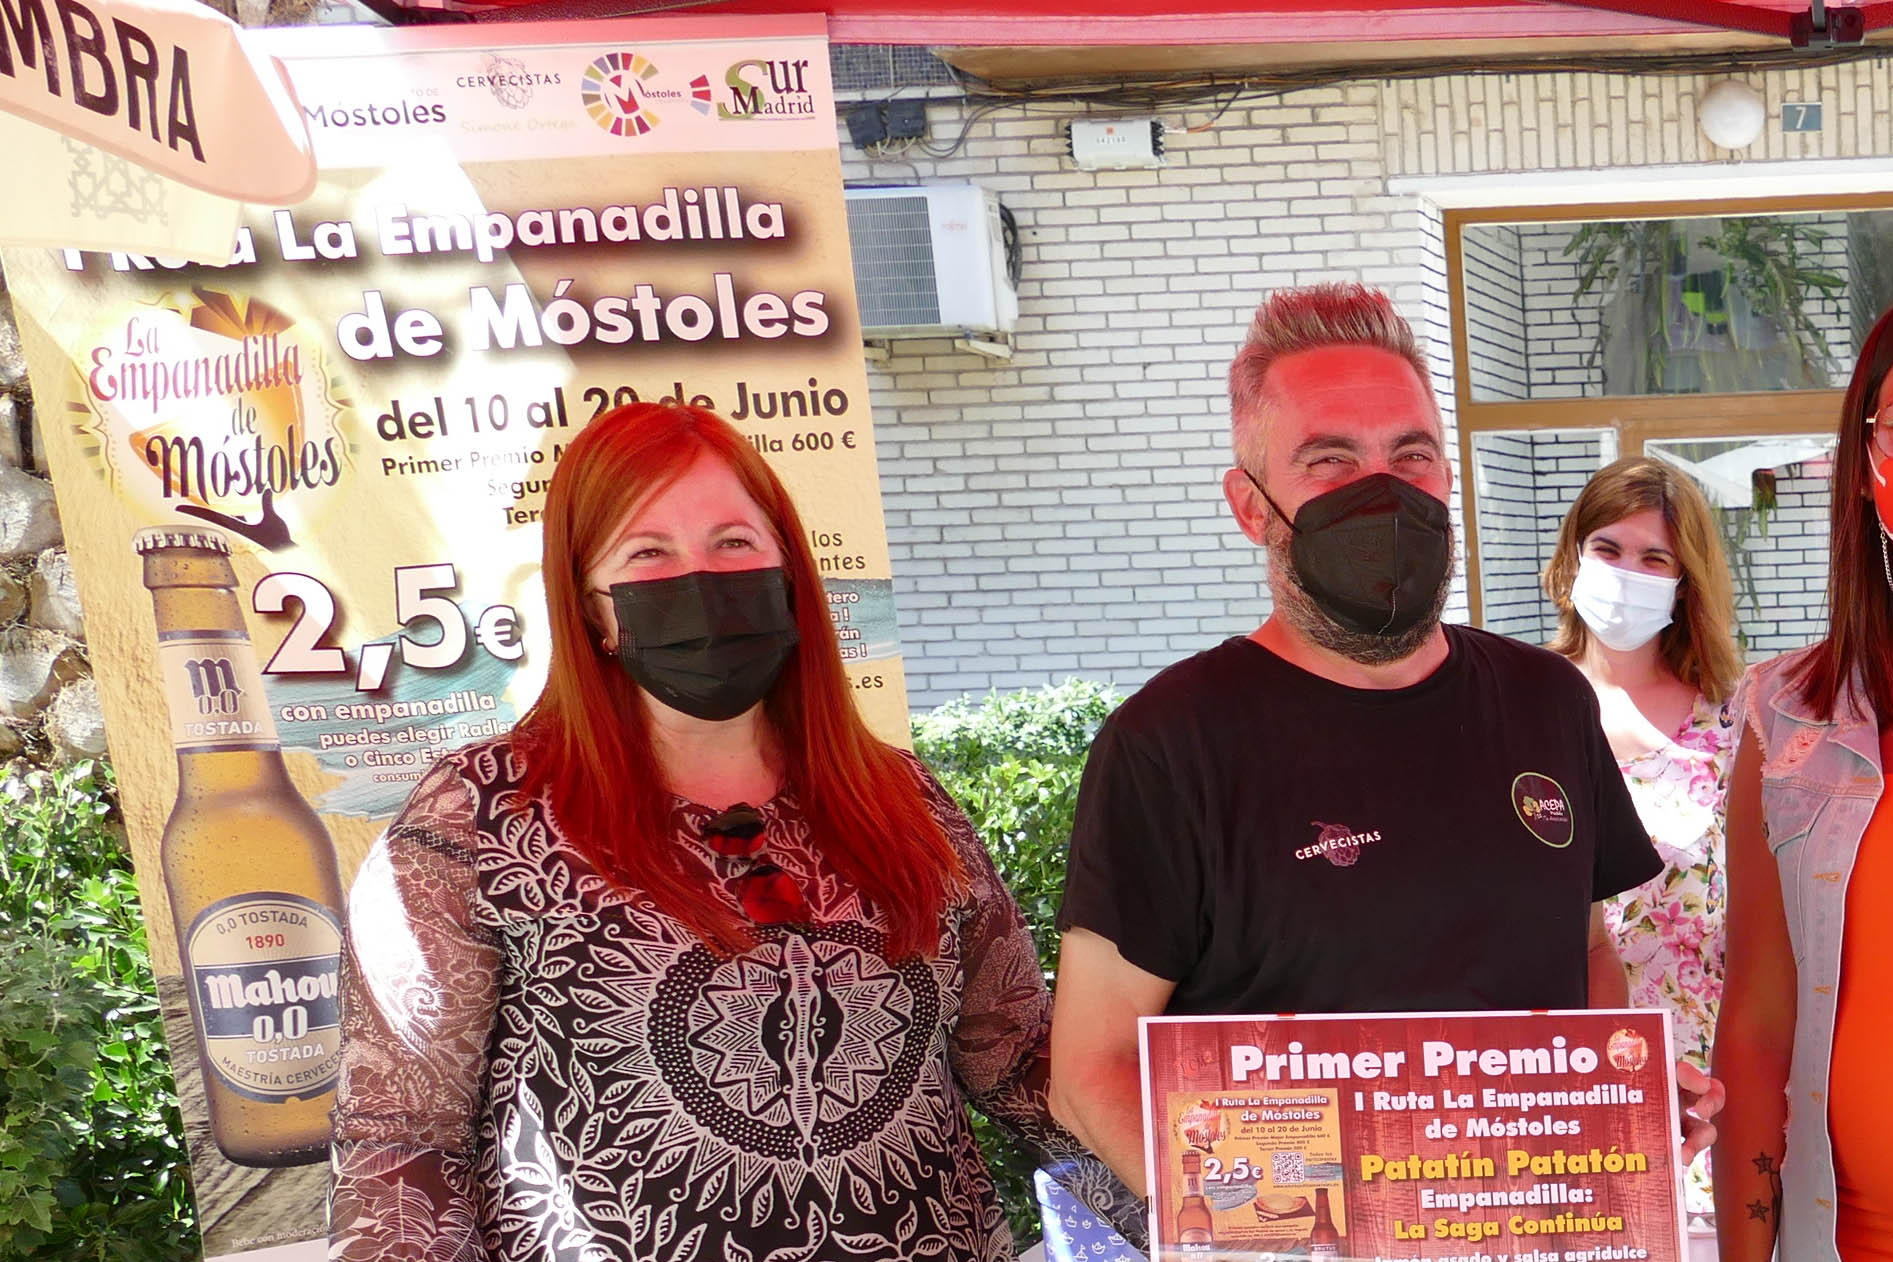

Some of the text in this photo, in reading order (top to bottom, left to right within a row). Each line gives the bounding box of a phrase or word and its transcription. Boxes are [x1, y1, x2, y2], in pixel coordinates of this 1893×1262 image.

[0, 0, 206, 163] MBRA
[457, 73, 562, 88] CERVECISTAS
[302, 100, 447, 128] Móstoles
[730, 86, 815, 115] Madrid
[1795, 106, 1807, 129] 7
[272, 209, 358, 261] La
[375, 187, 786, 262] Empanadilla
[337, 272, 830, 361] de Móstoles
[125, 317, 159, 357] La
[88, 332, 303, 414] Empanadilla
[231, 397, 257, 436] de
[376, 397, 449, 441] del
[465, 394, 510, 433] 10
[527, 387, 569, 428] al
[730, 377, 850, 420] Junio
[791, 431, 834, 451] 600
[842, 431, 857, 450] €
[145, 424, 342, 505] Móstoles
[381, 455, 462, 477] Primer
[812, 530, 843, 548] los
[281, 691, 496, 724] con empanadilla
[184, 721, 264, 736] TOSTADA
[319, 719, 514, 749] puedes elegir Radler
[345, 754, 359, 768] o
[362, 751, 416, 767] Cinco
[373, 771, 425, 783] consum
[1295, 830, 1382, 860] CERVECISTAS
[216, 911, 309, 935] 0,0 TOSTADA
[246, 934, 286, 950] 1890
[252, 1006, 309, 1043] 0,0
[222, 1050, 341, 1085] MAESTRÍA CERVECE
[246, 1044, 325, 1064] TOSTADA
[1230, 1036, 1600, 1082] Primer Premio
[1222, 1097, 1245, 1106] Ruta
[1248, 1097, 1260, 1106] La
[1263, 1095, 1328, 1106] Empanadilla
[1354, 1084, 1644, 1113] I Ruta La Empanadilla
[1241, 1109, 1321, 1121] de Móstoles
[1425, 1114, 1581, 1140] de Móstoles
[1359, 1146, 1648, 1181] Patatín Patatón
[1421, 1184, 1594, 1212] Empanadilla:
[1394, 1212, 1624, 1242] La Saga Continúa
